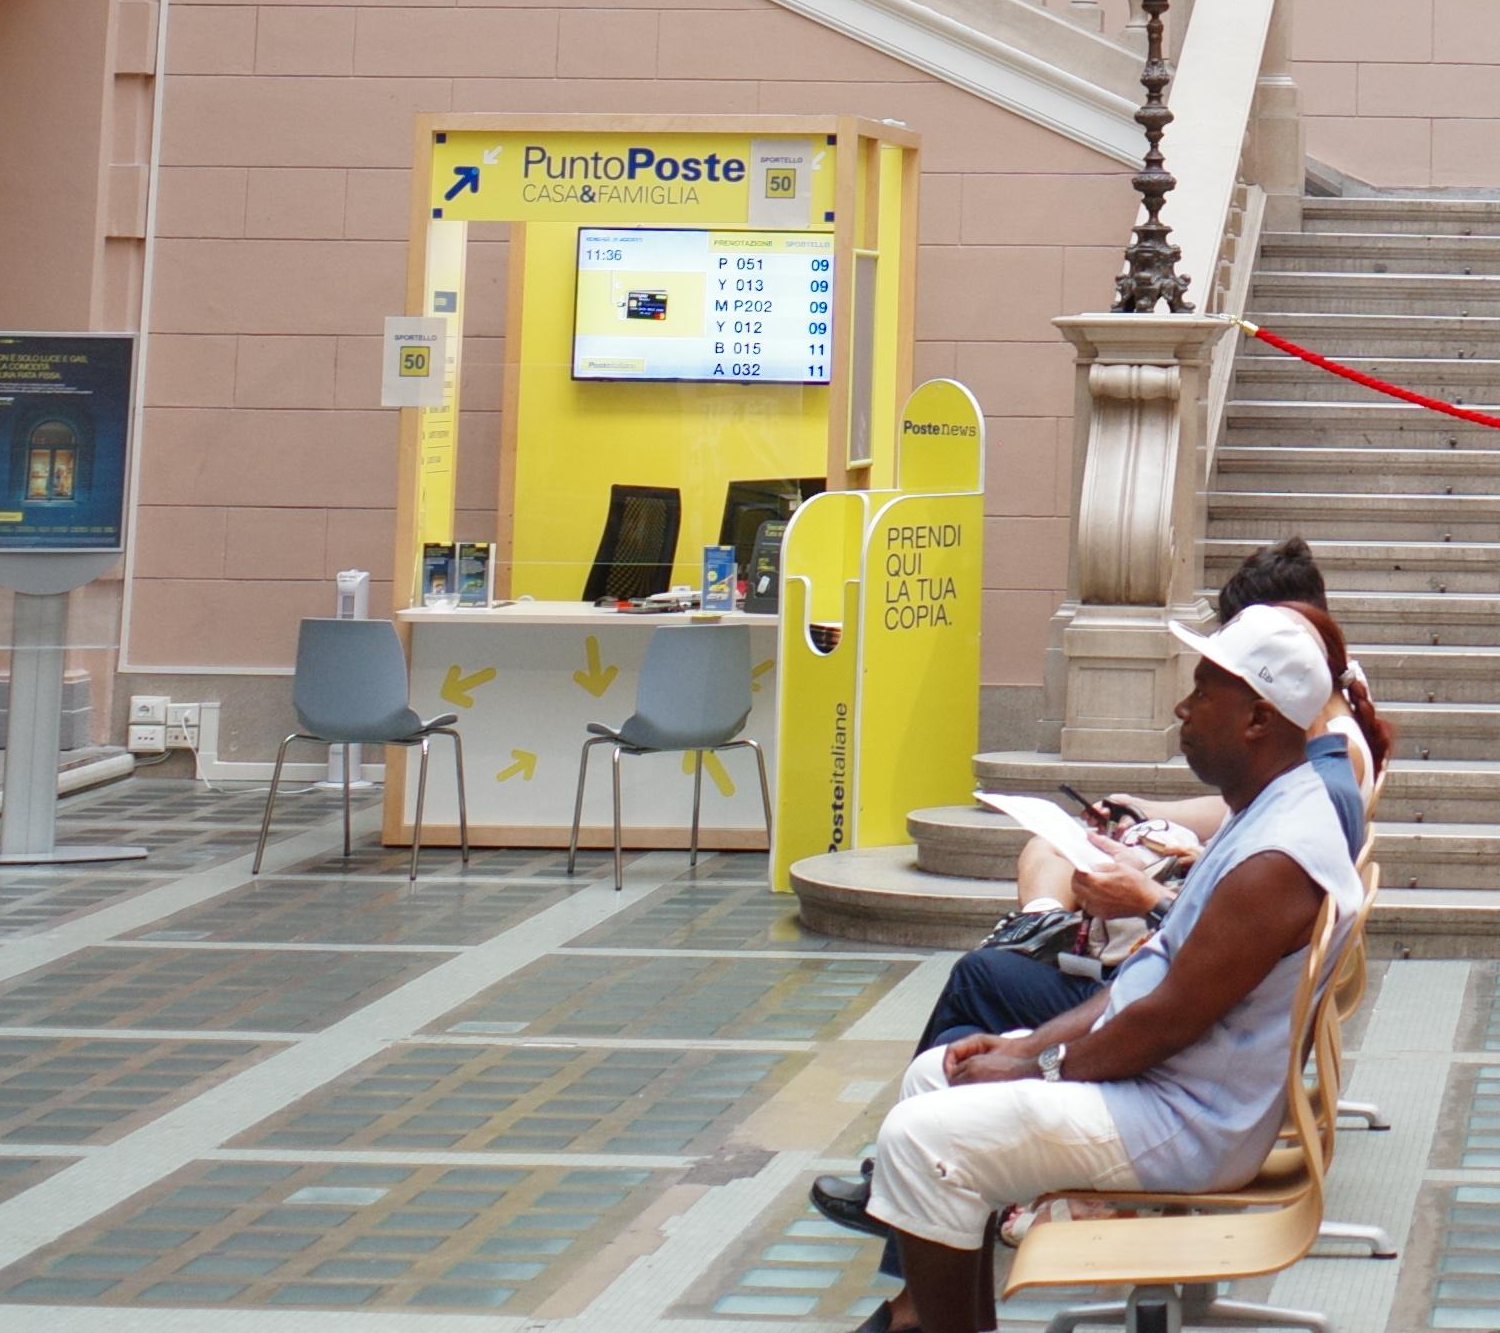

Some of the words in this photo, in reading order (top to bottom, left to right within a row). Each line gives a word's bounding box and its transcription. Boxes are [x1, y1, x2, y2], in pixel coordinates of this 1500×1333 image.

[523, 146, 745, 183] PuntoPoste
[760, 156, 803, 165] SPORTELLO
[770, 175, 792, 192] 50
[522, 183, 700, 206] CASA&FAMIGLIA
[714, 239, 773, 248] PRENOTAZIONE
[786, 240, 831, 248] SPORTELLO
[586, 249, 622, 262] 11:36
[719, 258, 728, 269] P
[737, 258, 763, 270] 051
[812, 259, 829, 272] 09
[718, 279, 727, 290] Y
[736, 279, 764, 291] 013
[811, 280, 829, 293] 09
[715, 300, 728, 312] M
[734, 300, 772, 313] P202
[810, 301, 828, 314] 09
[717, 321, 725, 333] Y
[734, 322, 762, 334] 012
[809, 323, 827, 335] 09
[394, 333, 438, 341] SPORTELLO
[715, 342, 724, 354] B
[733, 343, 761, 355] 015
[809, 344, 824, 356] 11
[40, 355, 61, 363] LUCE
[404, 353, 425, 371] 50
[714, 364, 724, 375] A
[732, 364, 761, 376] 032
[808, 365, 824, 377] 11
[904, 420, 977, 437] Postenews
[887, 524, 962, 550] PRENDI
[886, 553, 922, 577] QUI
[885, 580, 910, 604] LA
[916, 577, 957, 602] TUA
[884, 604, 953, 631] COPIA.
